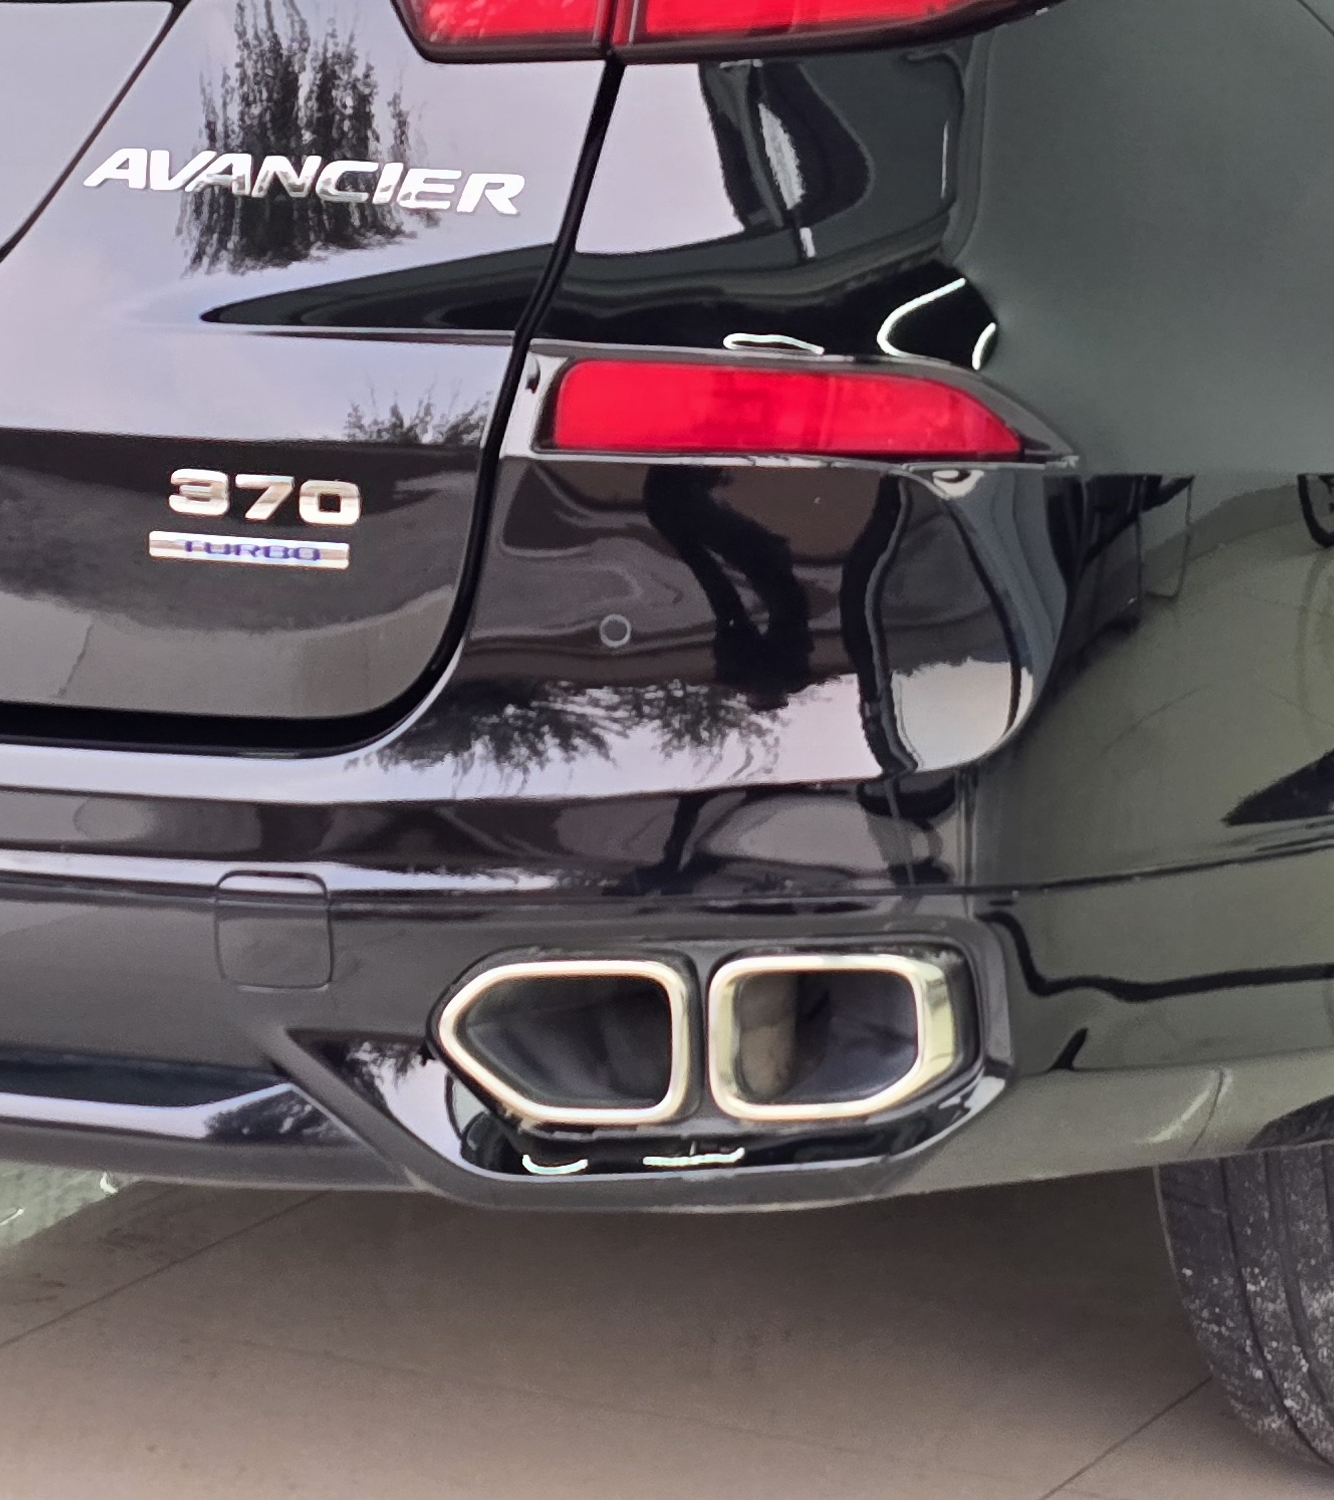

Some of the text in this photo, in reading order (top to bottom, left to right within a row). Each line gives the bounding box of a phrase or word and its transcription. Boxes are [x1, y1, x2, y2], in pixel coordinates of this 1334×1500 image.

[83, 148, 526, 216] AVANCIER
[168, 467, 362, 527] 370
[177, 538, 322, 562] TURBO
